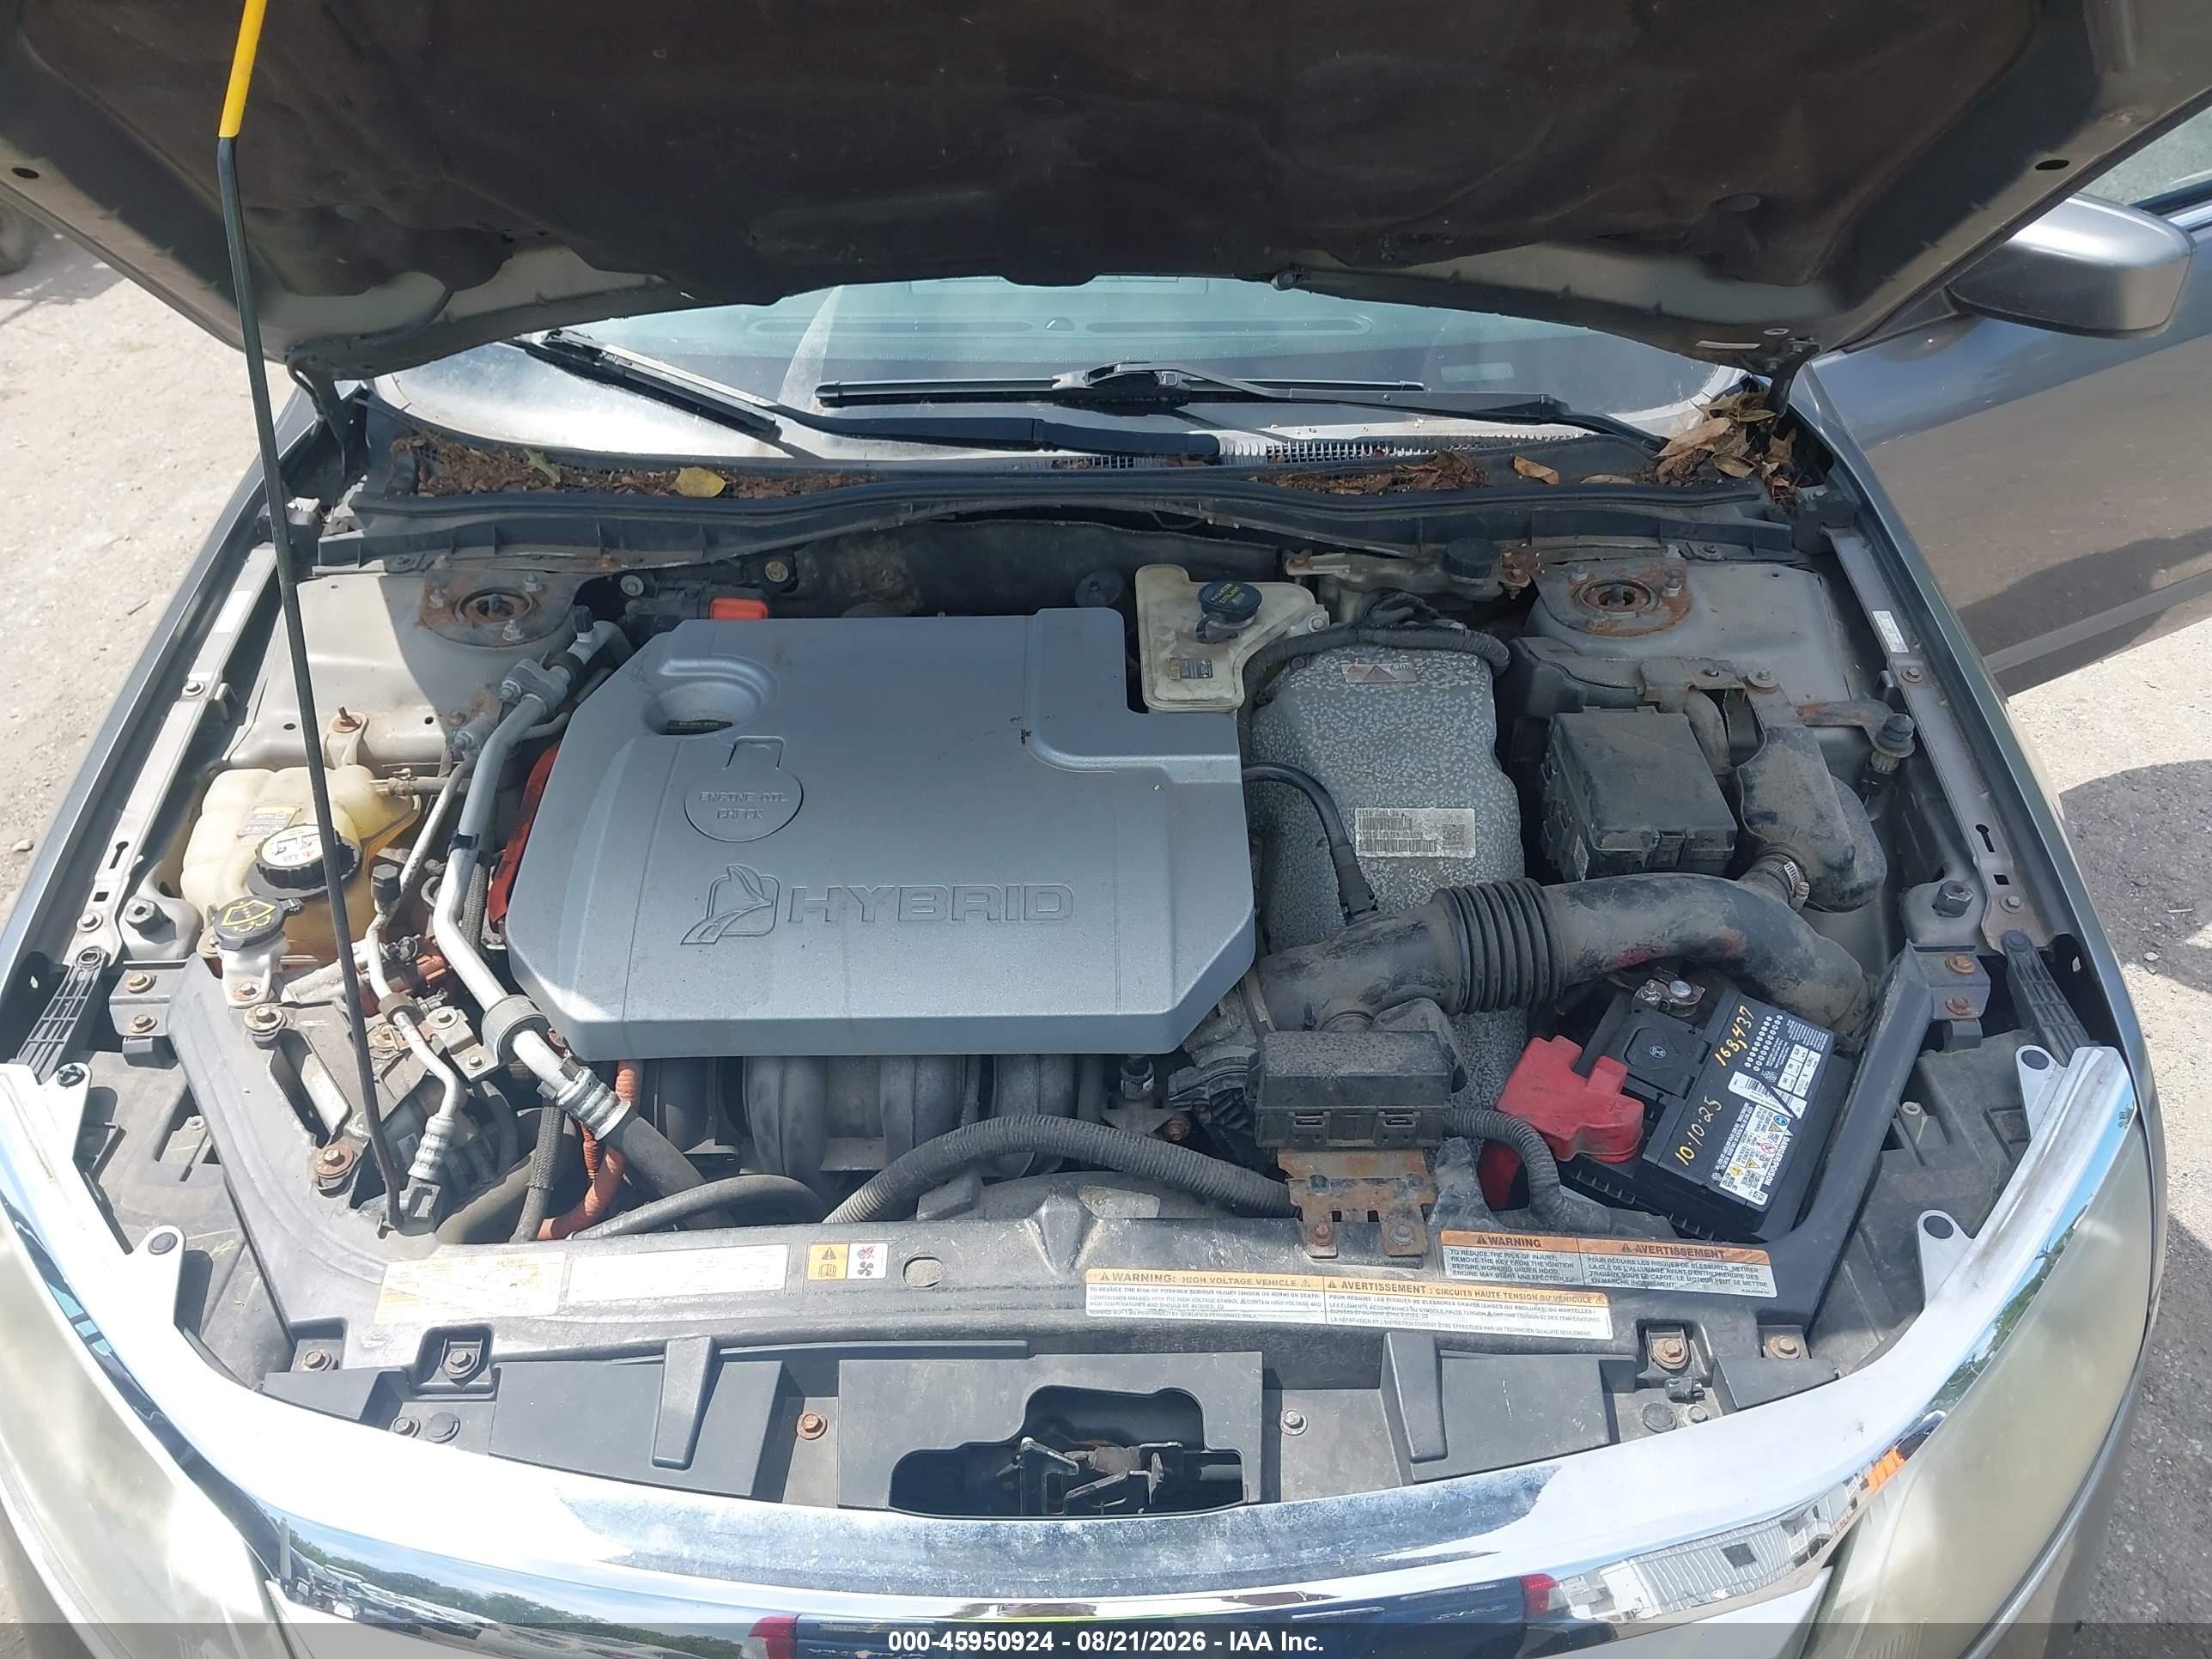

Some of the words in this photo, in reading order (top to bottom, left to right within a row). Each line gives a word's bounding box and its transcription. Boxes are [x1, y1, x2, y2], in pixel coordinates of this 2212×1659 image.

[759, 791, 789, 804] OIL
[790, 883, 1075, 923] HYBRID
[1714, 1003, 1755, 1068] 168,437
[1488, 1236, 1541, 1248] WARNING
[1633, 1244, 1725, 1258] AVERTISSEMENT
[1112, 1273, 1176, 1282] WARNING:
[1340, 1280, 1426, 1293] AVERTISSEMENT
[1435, 1288, 1473, 1297] CIRCUITS
[1502, 1291, 1538, 1300] TENSION
